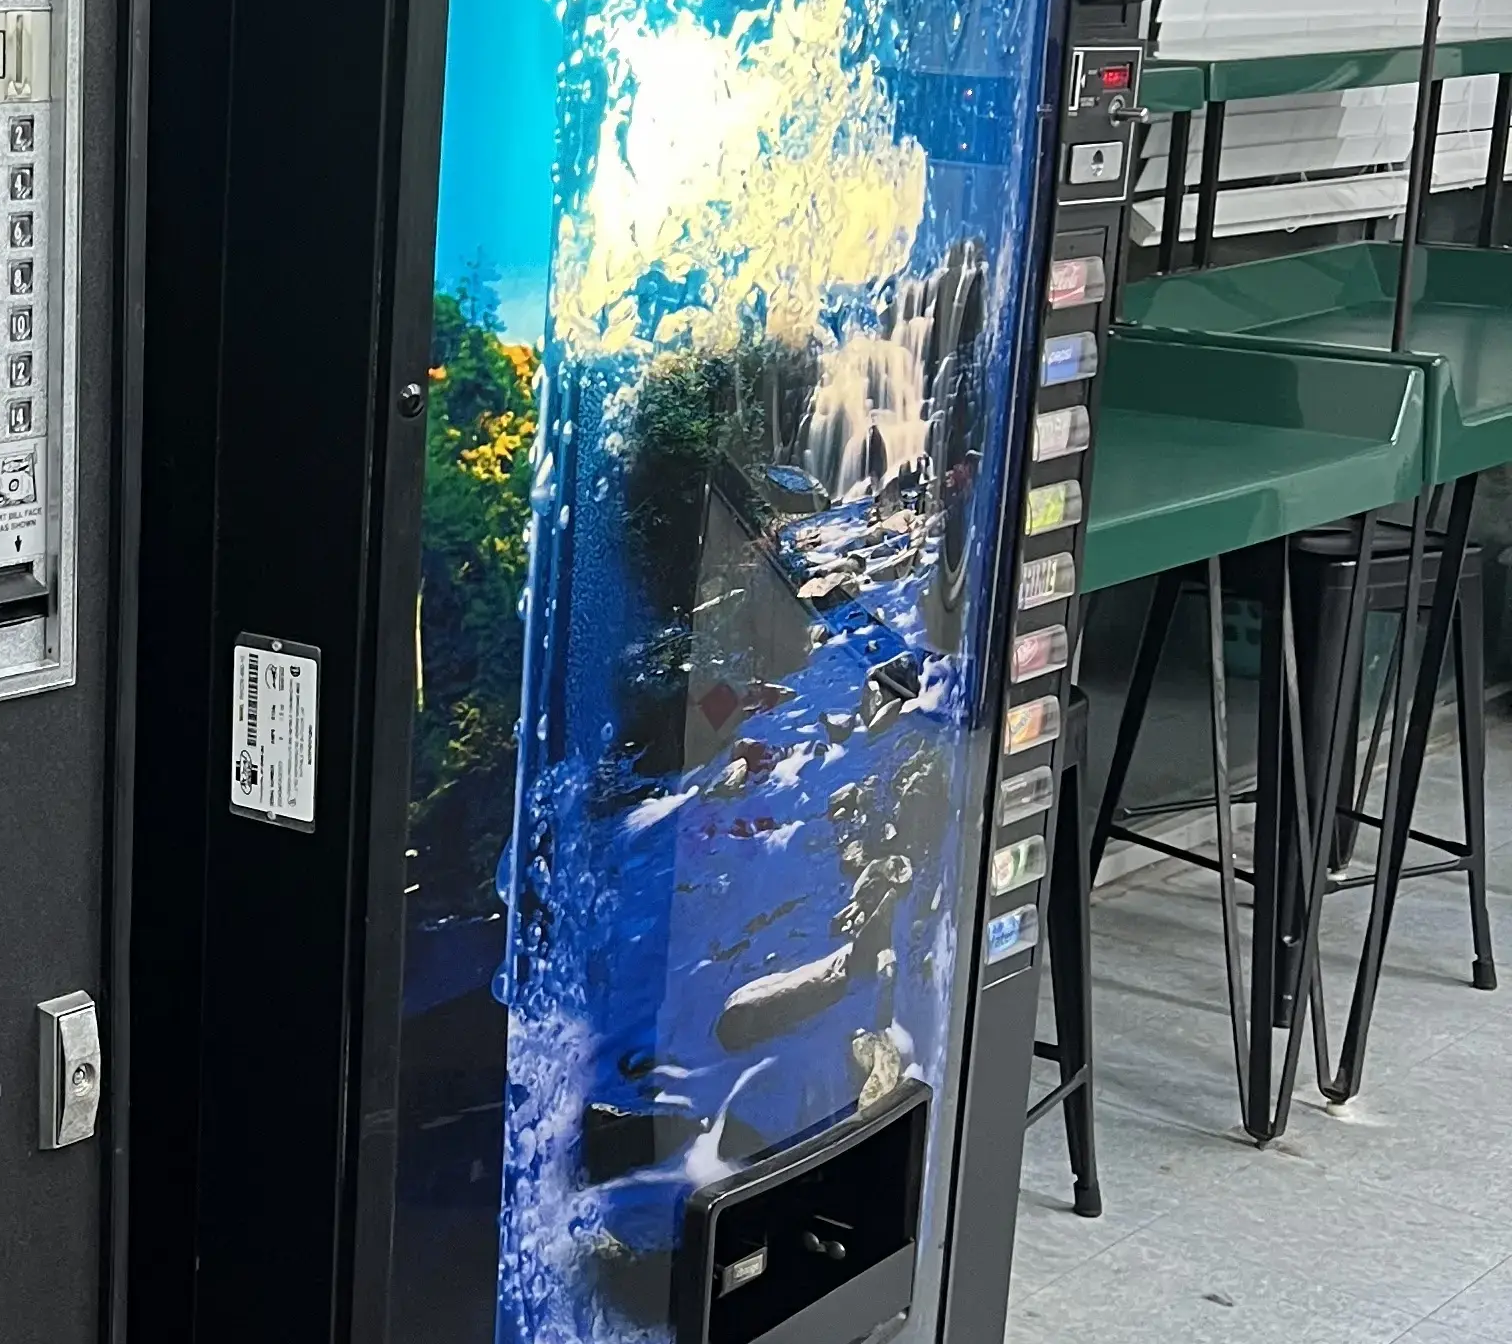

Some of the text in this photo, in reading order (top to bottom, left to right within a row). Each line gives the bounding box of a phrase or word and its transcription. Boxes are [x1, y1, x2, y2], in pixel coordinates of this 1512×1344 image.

[13, 269, 22, 287] 8
[12, 316, 26, 333] 10
[12, 362, 25, 380] 12
[11, 408, 25, 426] 14
